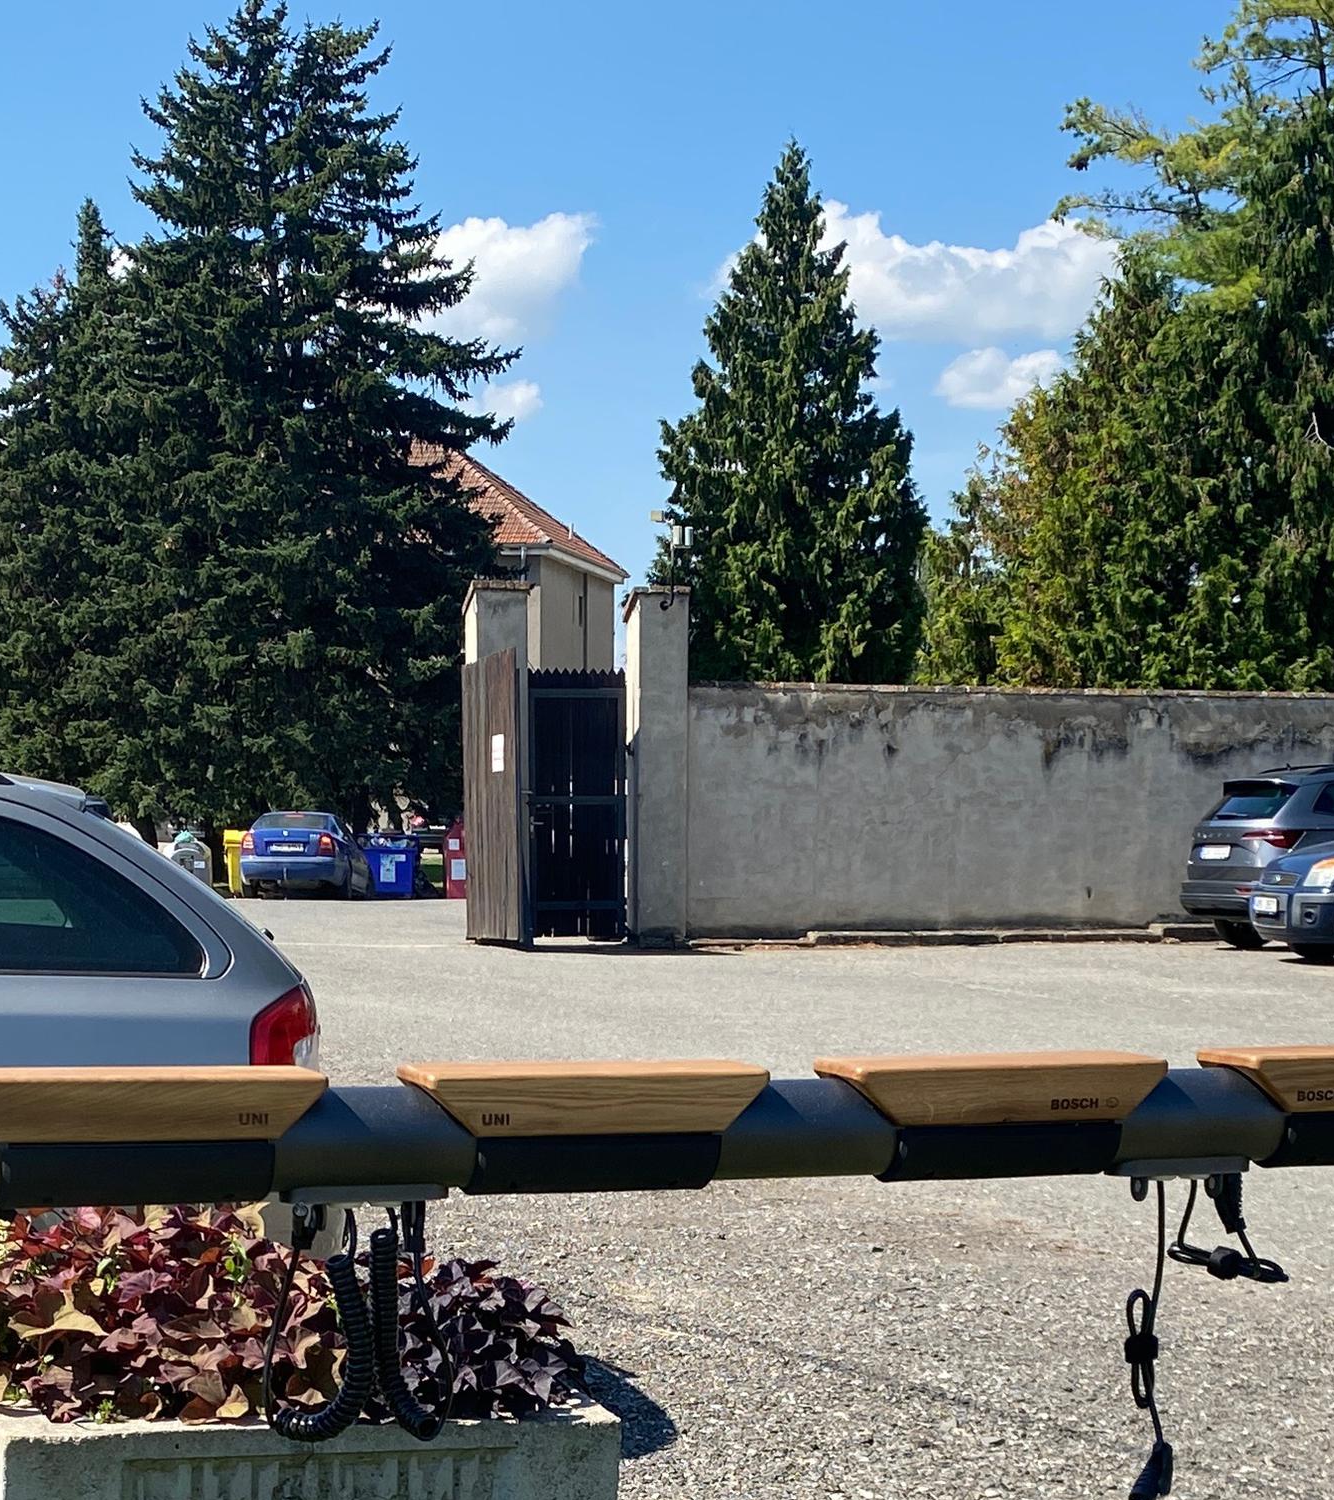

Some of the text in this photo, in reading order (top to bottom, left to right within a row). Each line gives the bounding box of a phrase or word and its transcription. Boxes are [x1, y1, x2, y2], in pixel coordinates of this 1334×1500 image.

[1050, 1097, 1099, 1111] BOSCH
[238, 1112, 269, 1126] UNI
[481, 1112, 510, 1127] UNI
